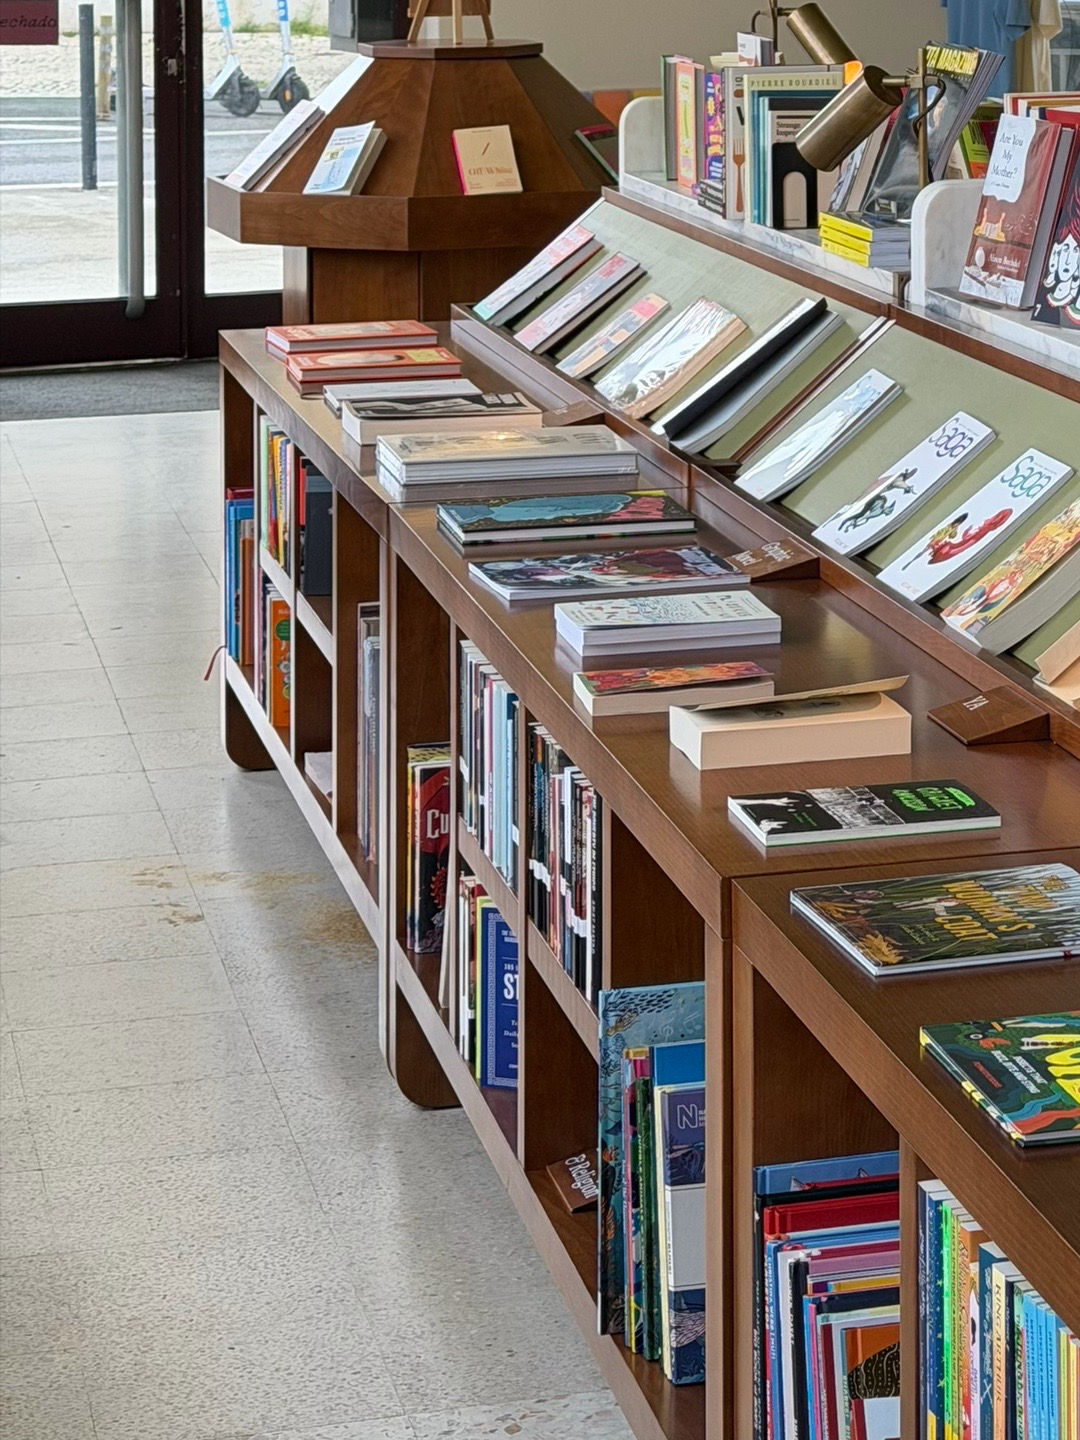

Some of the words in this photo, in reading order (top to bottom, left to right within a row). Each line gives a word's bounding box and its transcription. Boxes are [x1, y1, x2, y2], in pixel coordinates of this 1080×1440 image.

[0, 15, 56, 28] echado
[938, 48, 980, 75] MAGAZINE
[750, 79, 786, 88] PIERRE
[999, 132, 1011, 144] Are
[1012, 134, 1024, 147] You
[1002, 149, 1013, 162] My
[991, 165, 1018, 180] Mother?
[928, 417, 973, 460] Saga
[1000, 455, 1051, 500] Saga
[733, 549, 762, 567] Novel
[761, 542, 794, 562] Graphic
[963, 695, 989, 711] YA
[934, 914, 999, 941] COAT
[677, 1104, 699, 1130] N
[565, 1154, 585, 1166] &
[569, 1160, 599, 1198] Religion
[995, 1328, 1003, 1402] ARTHUR
